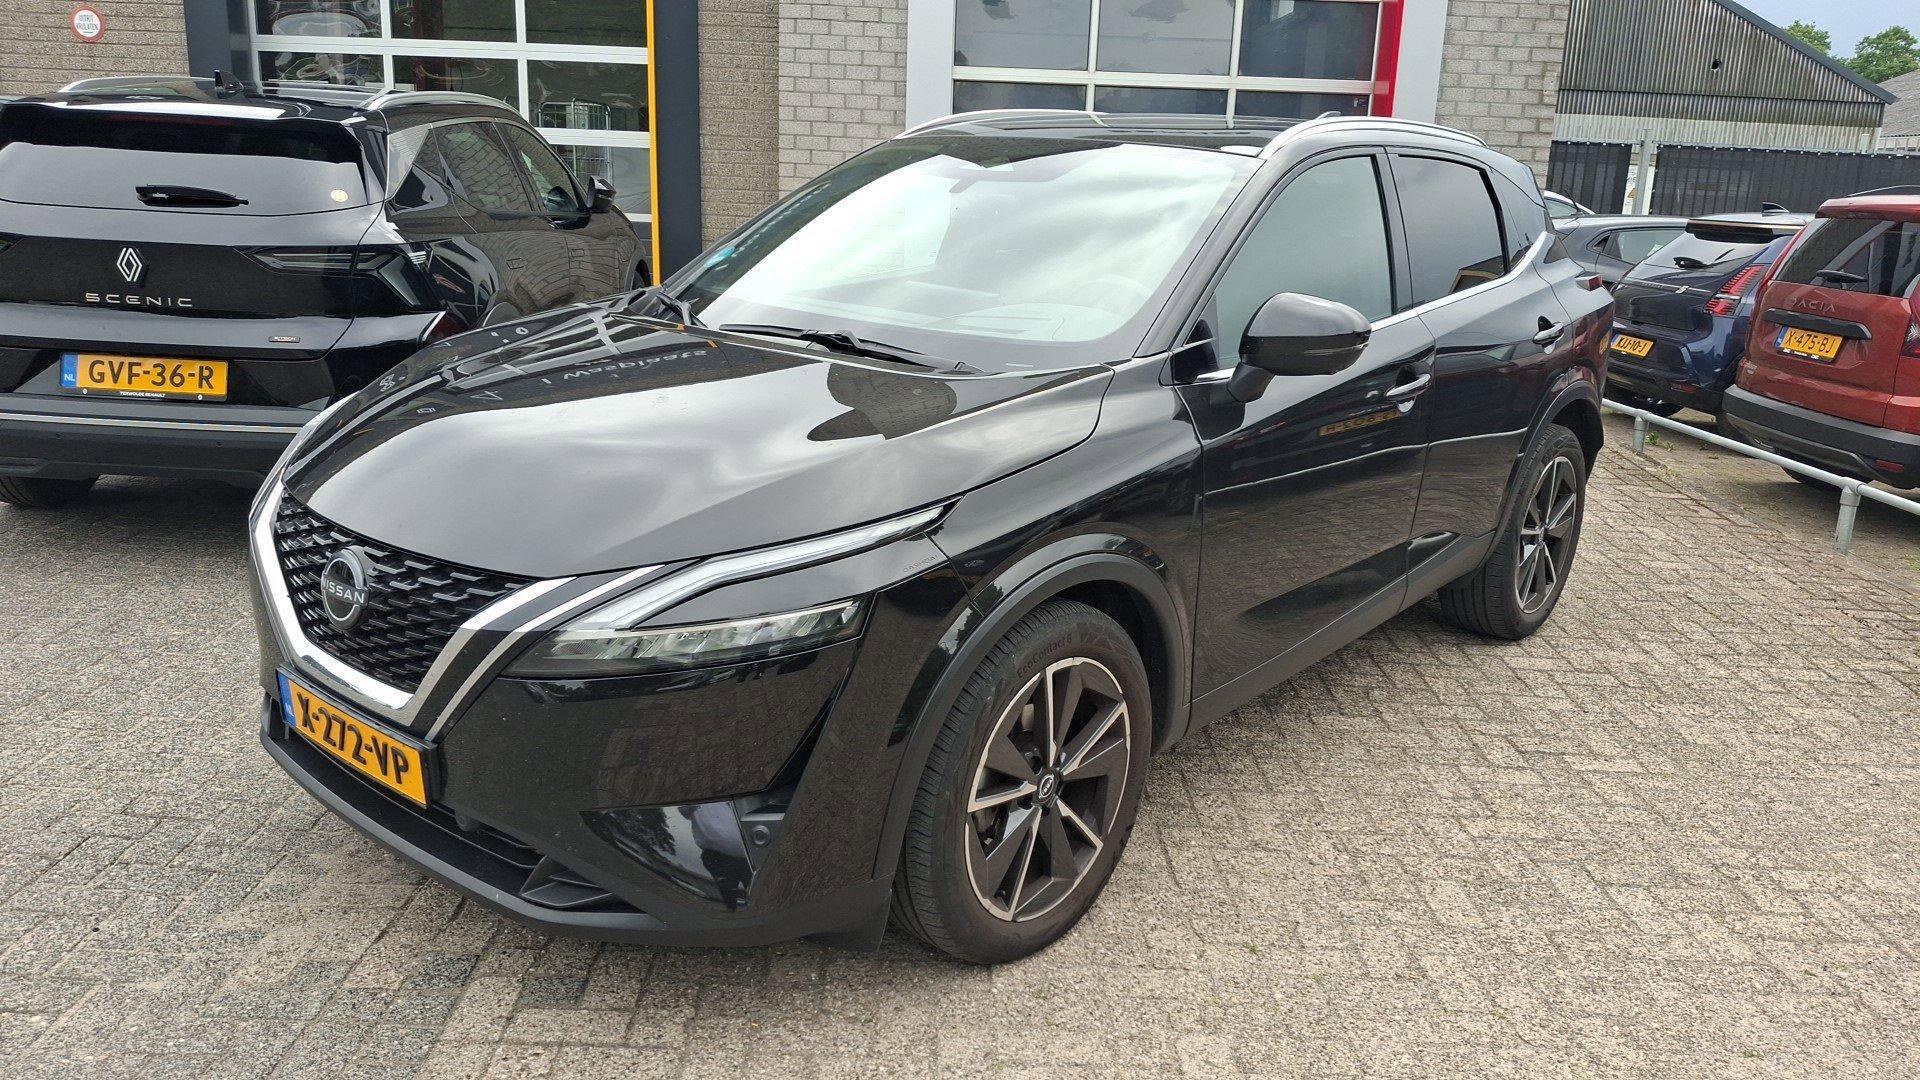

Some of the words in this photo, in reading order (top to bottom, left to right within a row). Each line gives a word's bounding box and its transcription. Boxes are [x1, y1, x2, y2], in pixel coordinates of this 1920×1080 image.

[85, 292, 193, 308] SCENIC
[1792, 296, 1836, 313] DACIA
[1616, 336, 1648, 353] KJJ-10-J
[1785, 330, 1836, 354] X-475-BJ
[64, 373, 76, 382] NL
[88, 359, 214, 390] GVF-36-R
[321, 576, 365, 604] NISSAN
[1016, 636, 1066, 678] EcoContact
[296, 691, 409, 785] X-272-VP
